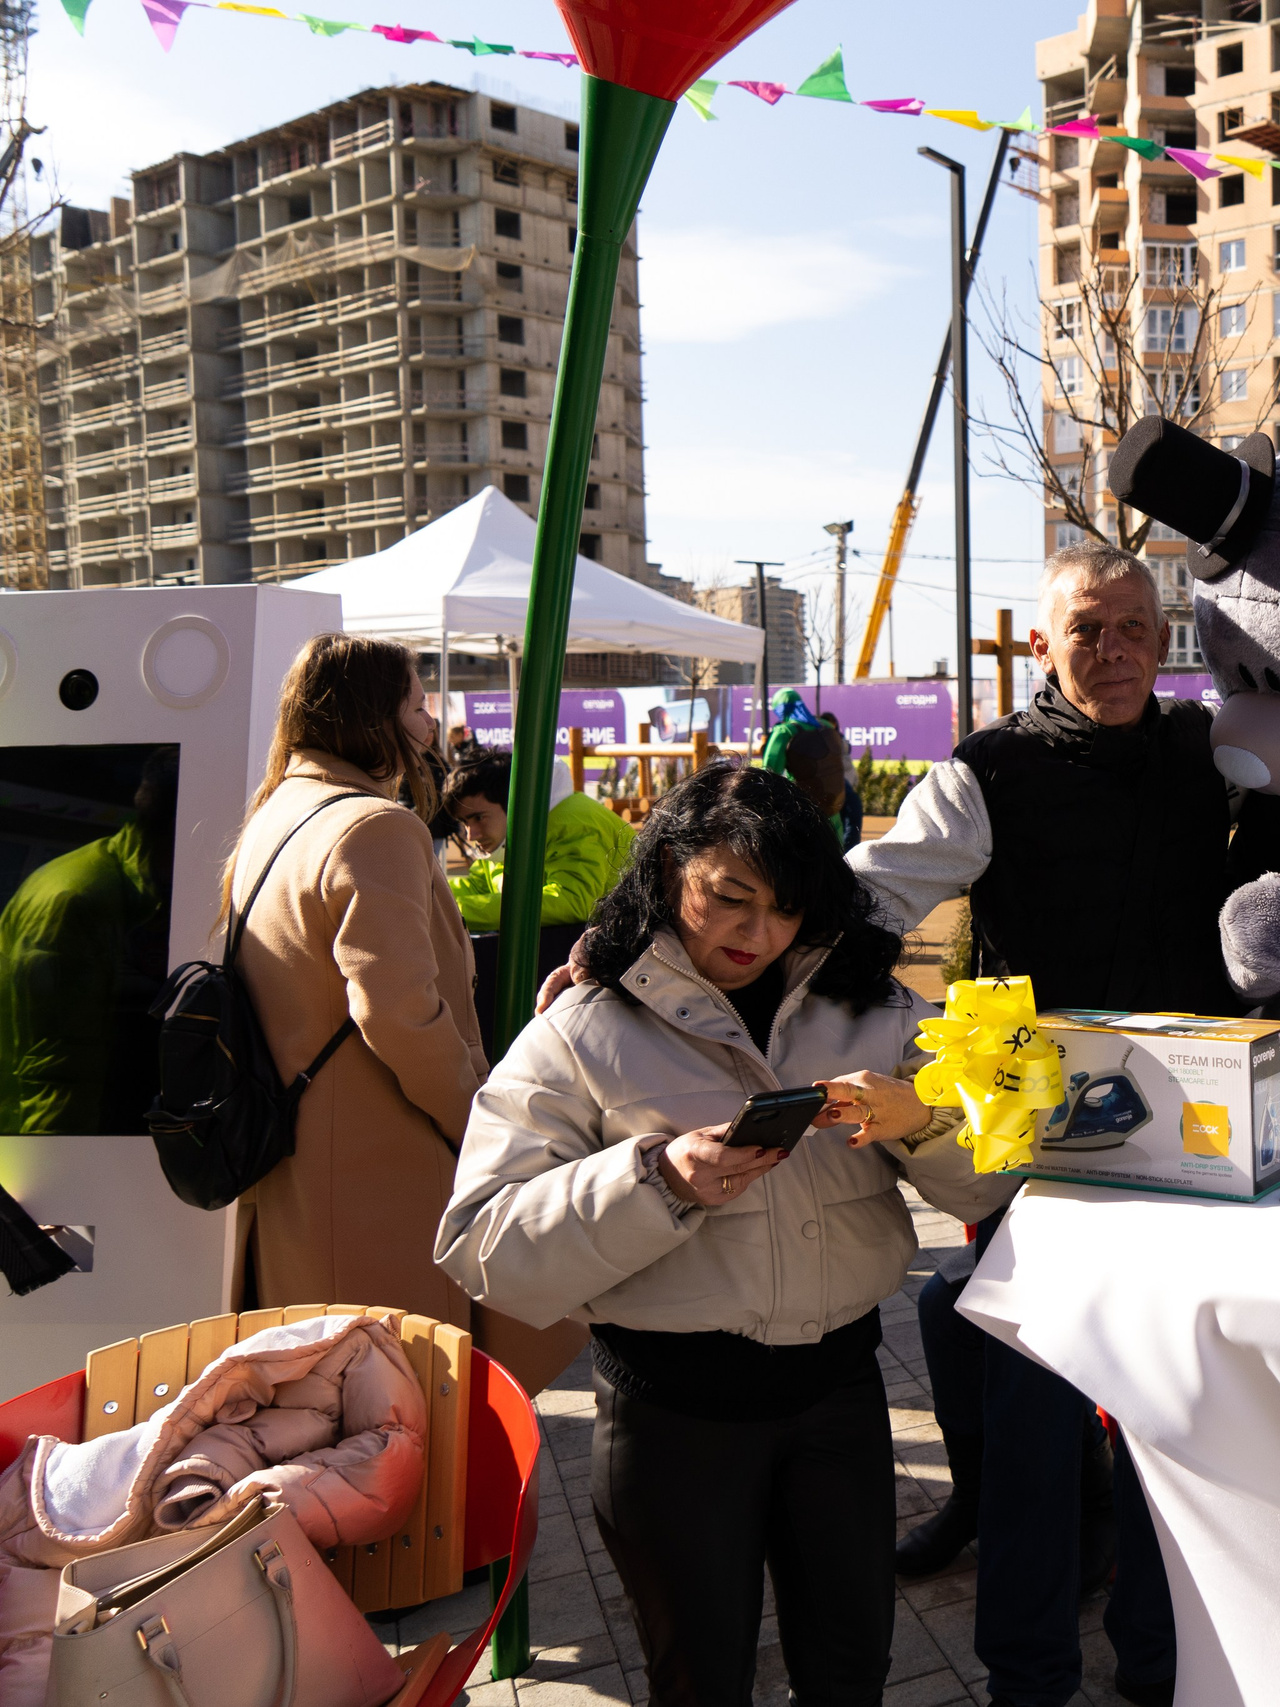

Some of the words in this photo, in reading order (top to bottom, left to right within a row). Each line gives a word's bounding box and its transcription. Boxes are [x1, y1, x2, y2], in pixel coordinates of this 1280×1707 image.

[895, 694, 938, 706] СЕГОДНЯ
[1168, 1053, 1209, 1067] STEAM
[1212, 1056, 1242, 1069] IRON
[1252, 1046, 1276, 1068] gorenje
[1168, 1075, 1205, 1084] STEAMCARE
[1206, 1078, 1219, 1086] LITE
[1180, 1161, 1208, 1170] ANTI-DRIP
[1209, 1164, 1234, 1172] SYSTEM
[1086, 1169, 1110, 1177] ANTI-DRIP
[1111, 1171, 1131, 1179] SYSTEM
[1135, 1174, 1163, 1183] NON-STICK
[1164, 1177, 1193, 1186] SOLEPLATE
